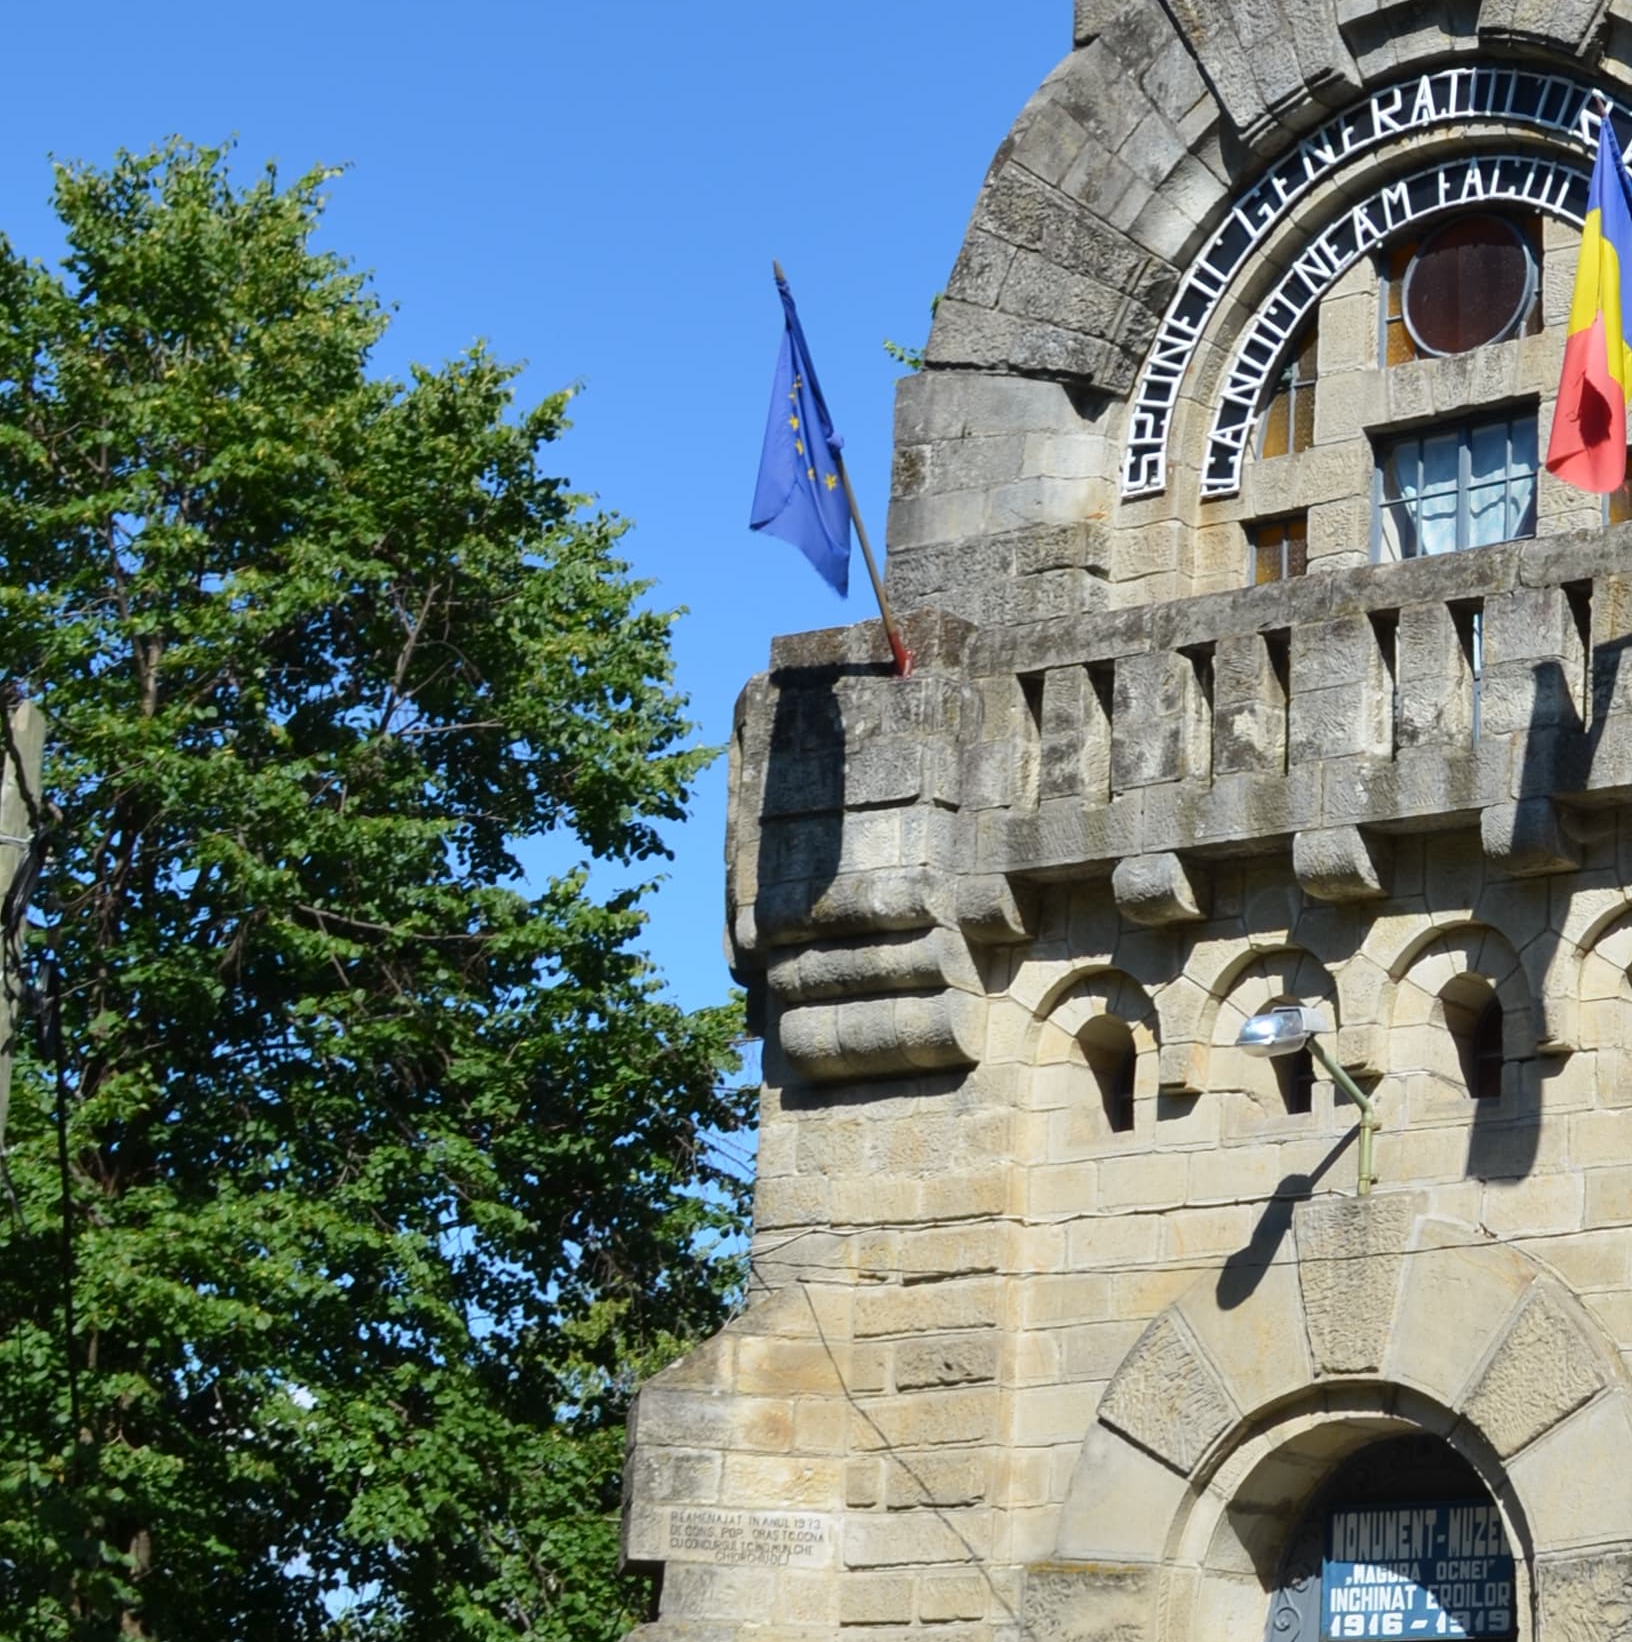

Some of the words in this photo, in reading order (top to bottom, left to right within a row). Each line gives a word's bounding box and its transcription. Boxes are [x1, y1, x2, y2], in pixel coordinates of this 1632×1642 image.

[1330, 1584, 1417, 1613] INCHINAT
[1427, 1581, 1511, 1608] EROILOR
[1330, 1612, 1403, 1637] 1916
[1436, 1609, 1511, 1634] 1919
